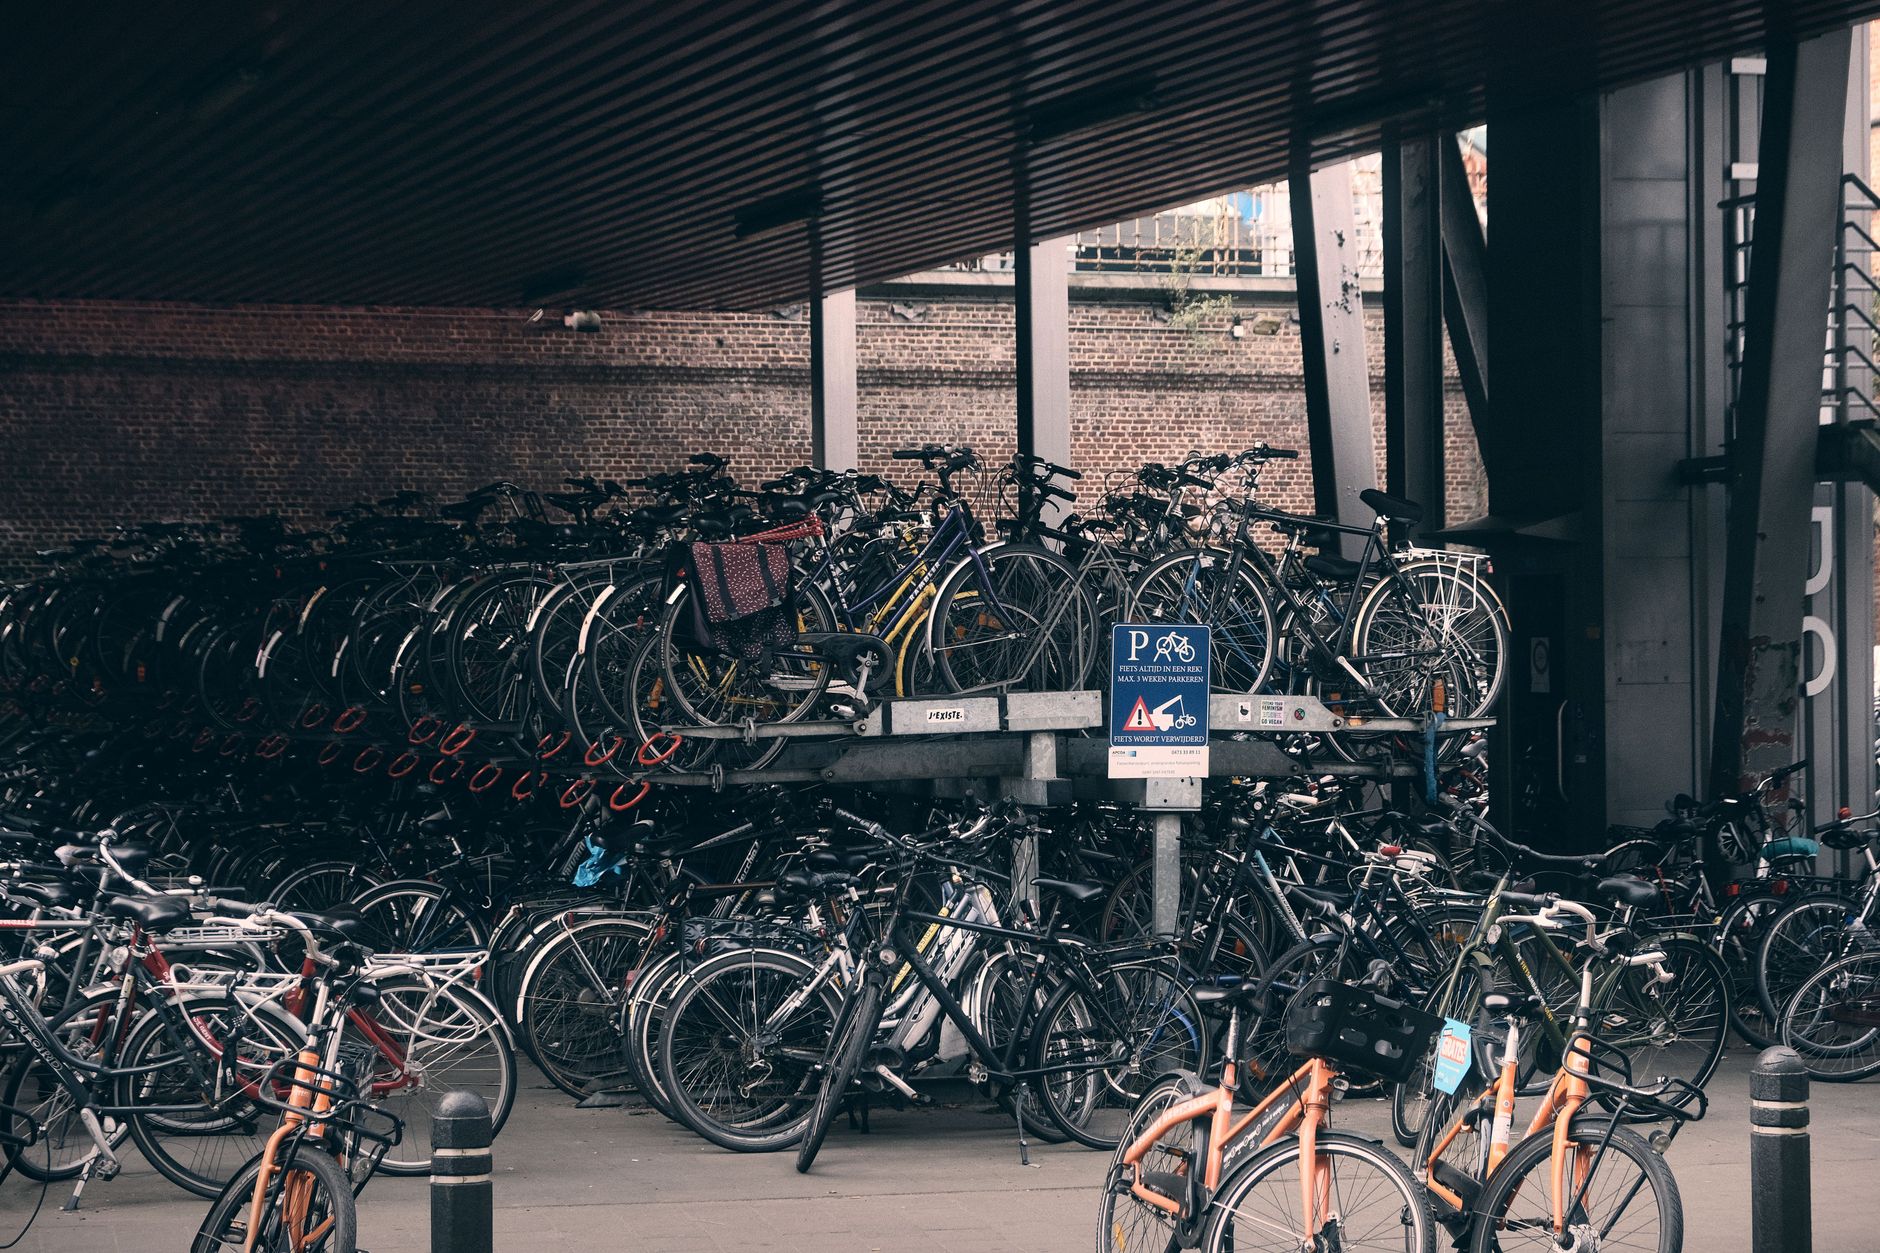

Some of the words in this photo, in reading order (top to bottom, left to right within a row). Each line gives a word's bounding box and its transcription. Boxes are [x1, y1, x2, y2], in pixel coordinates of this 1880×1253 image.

[909, 561, 940, 601] RAMBLER
[1127, 630, 1149, 661] P
[1117, 675, 1135, 683] MAX.
[1136, 675, 1141, 683] 3
[1141, 675, 1167, 683] WEKEN
[1168, 675, 1204, 683] PARKEREN
[1119, 665, 1138, 673] FIETS
[1139, 665, 1162, 674] ALTIJD
[1163, 665, 1172, 673] IN
[1172, 665, 1186, 673] EEN
[1187, 665, 1203, 673] REK!
[1113, 735, 1133, 743] FIETS
[1133, 735, 1160, 743] WORDT
[1161, 735, 1205, 744] VERWIJDERD
[2, 1007, 64, 1071] OXFORD
